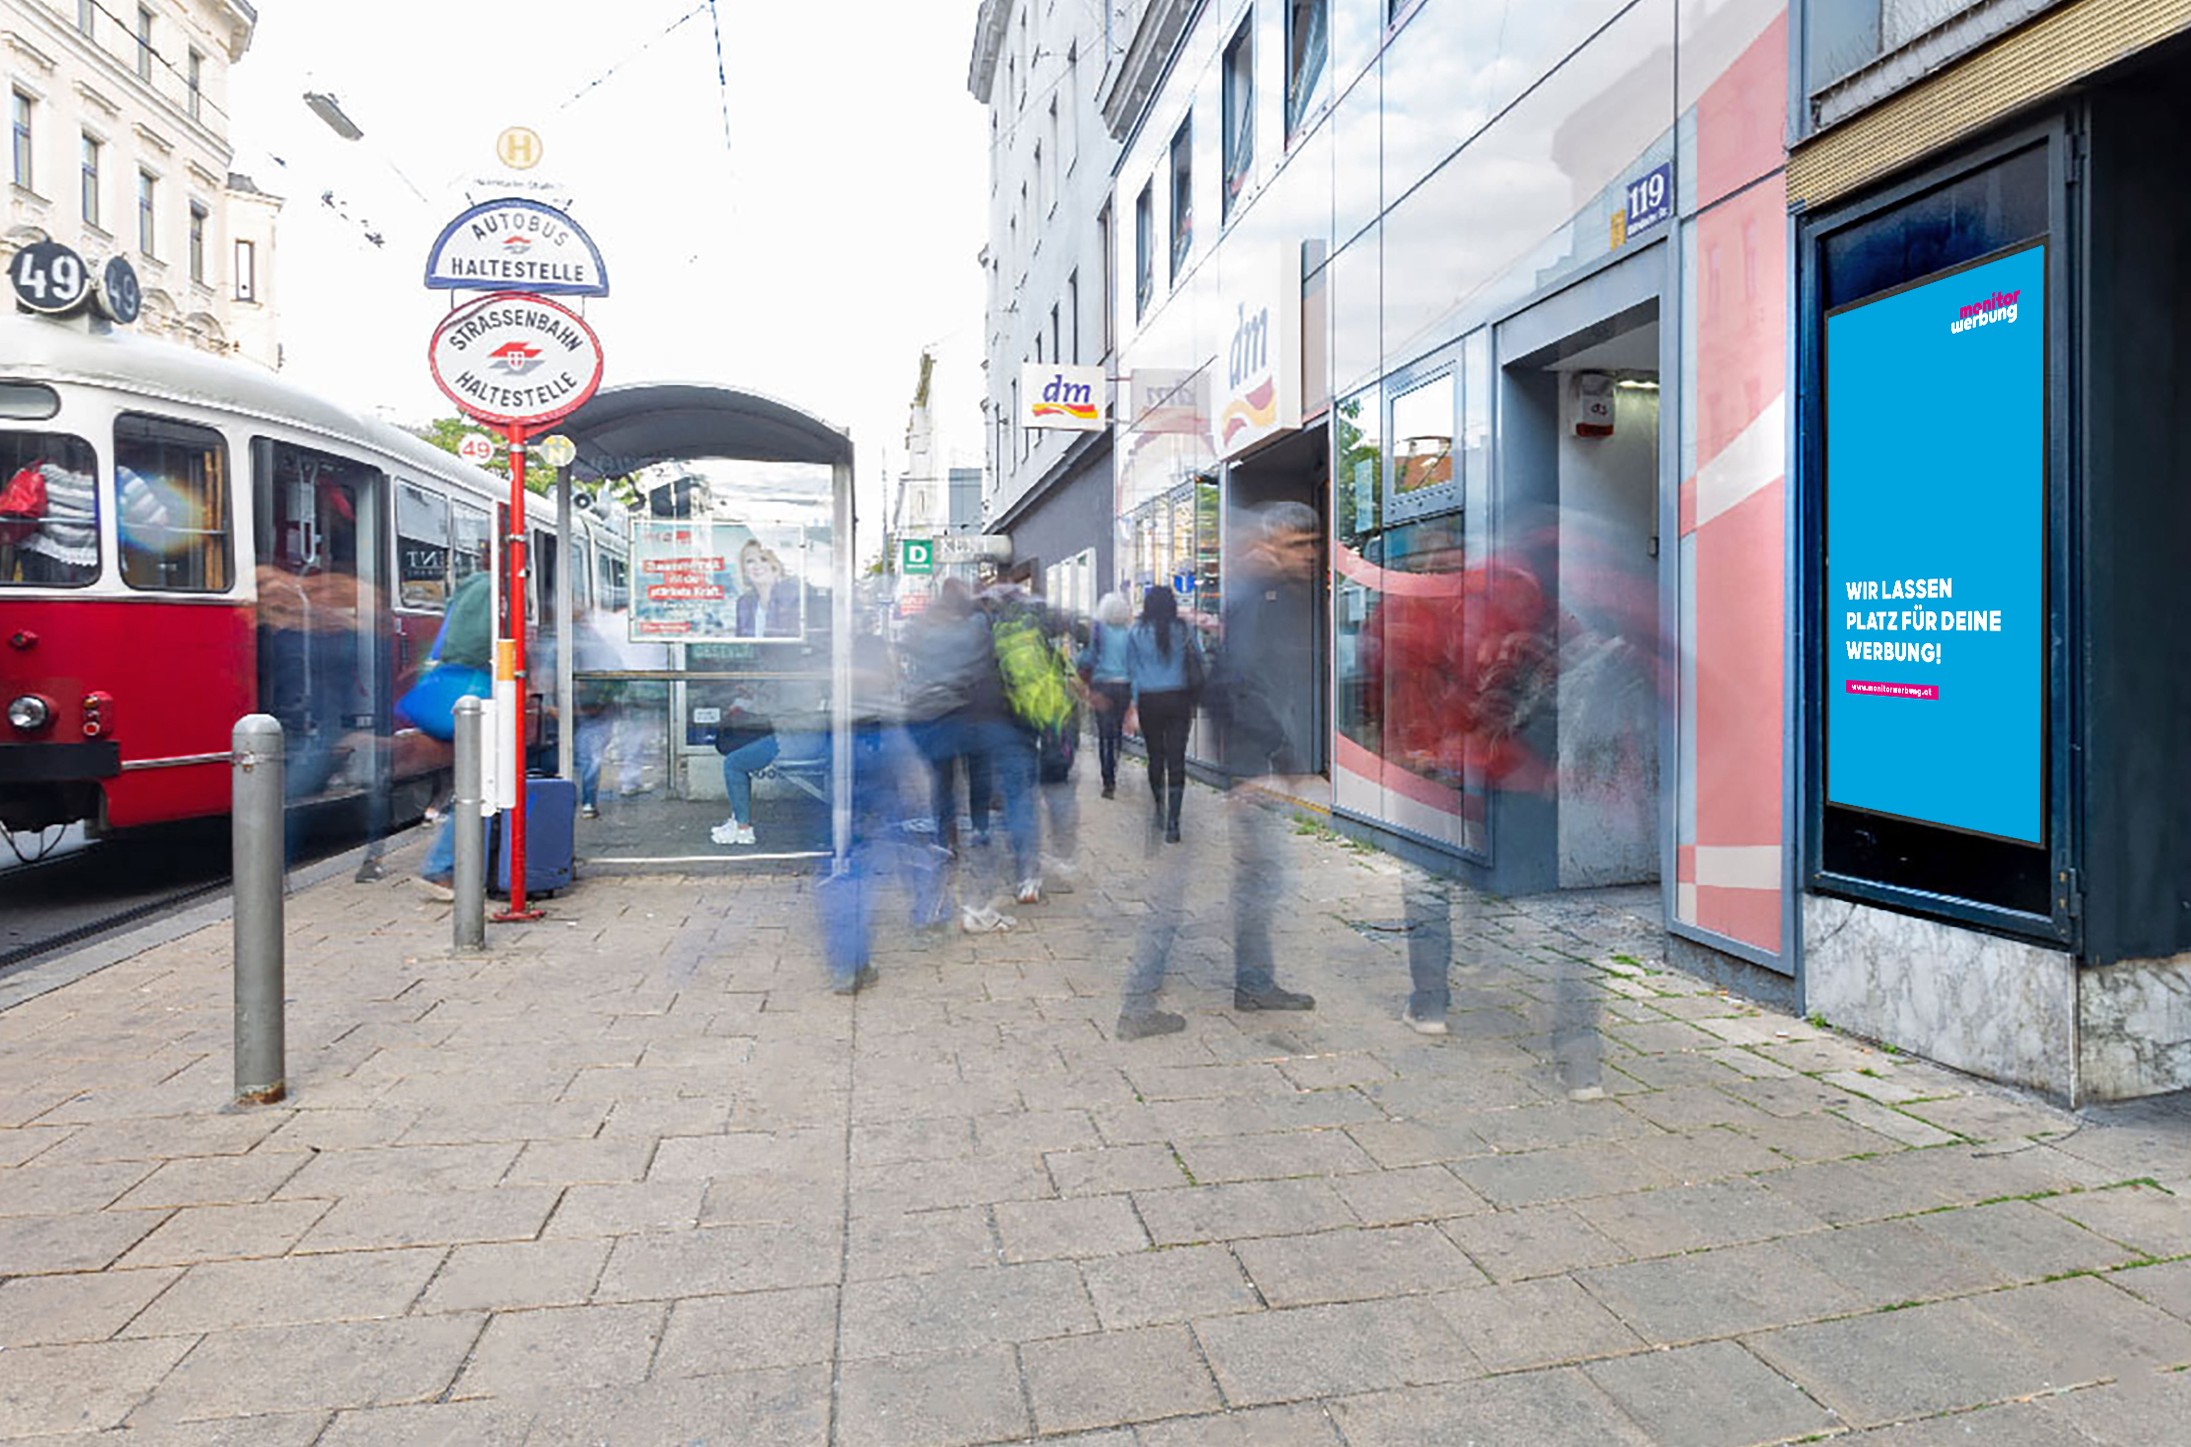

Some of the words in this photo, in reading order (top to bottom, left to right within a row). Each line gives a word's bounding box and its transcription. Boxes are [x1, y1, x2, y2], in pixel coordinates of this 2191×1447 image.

[508, 134, 531, 161] H
[1630, 173, 1664, 219] 119
[471, 213, 570, 247] AUTOBUS
[19, 253, 80, 300] 49
[452, 257, 585, 282] HALTESTELLE
[108, 263, 135, 316] 49
[1960, 289, 2021, 319] monitor
[449, 309, 583, 353] STRASSENBAHN
[1950, 303, 2018, 334] werbung
[1229, 302, 1268, 390] dm
[454, 369, 578, 408] HALTESTELLE
[1043, 374, 1091, 403] dm
[462, 440, 491, 459] 49
[909, 545, 928, 563] D
[1846, 581, 1878, 600] WIR
[1882, 578, 1952, 600] LASSEN
[1846, 611, 1898, 630] PLATZ
[1901, 604, 1937, 631] FÜR
[1941, 610, 2002, 632] DEINE
[1846, 641, 1941, 664] WERBUNG!
[1851, 684, 1932, 697] www.monitorwerbung.at
